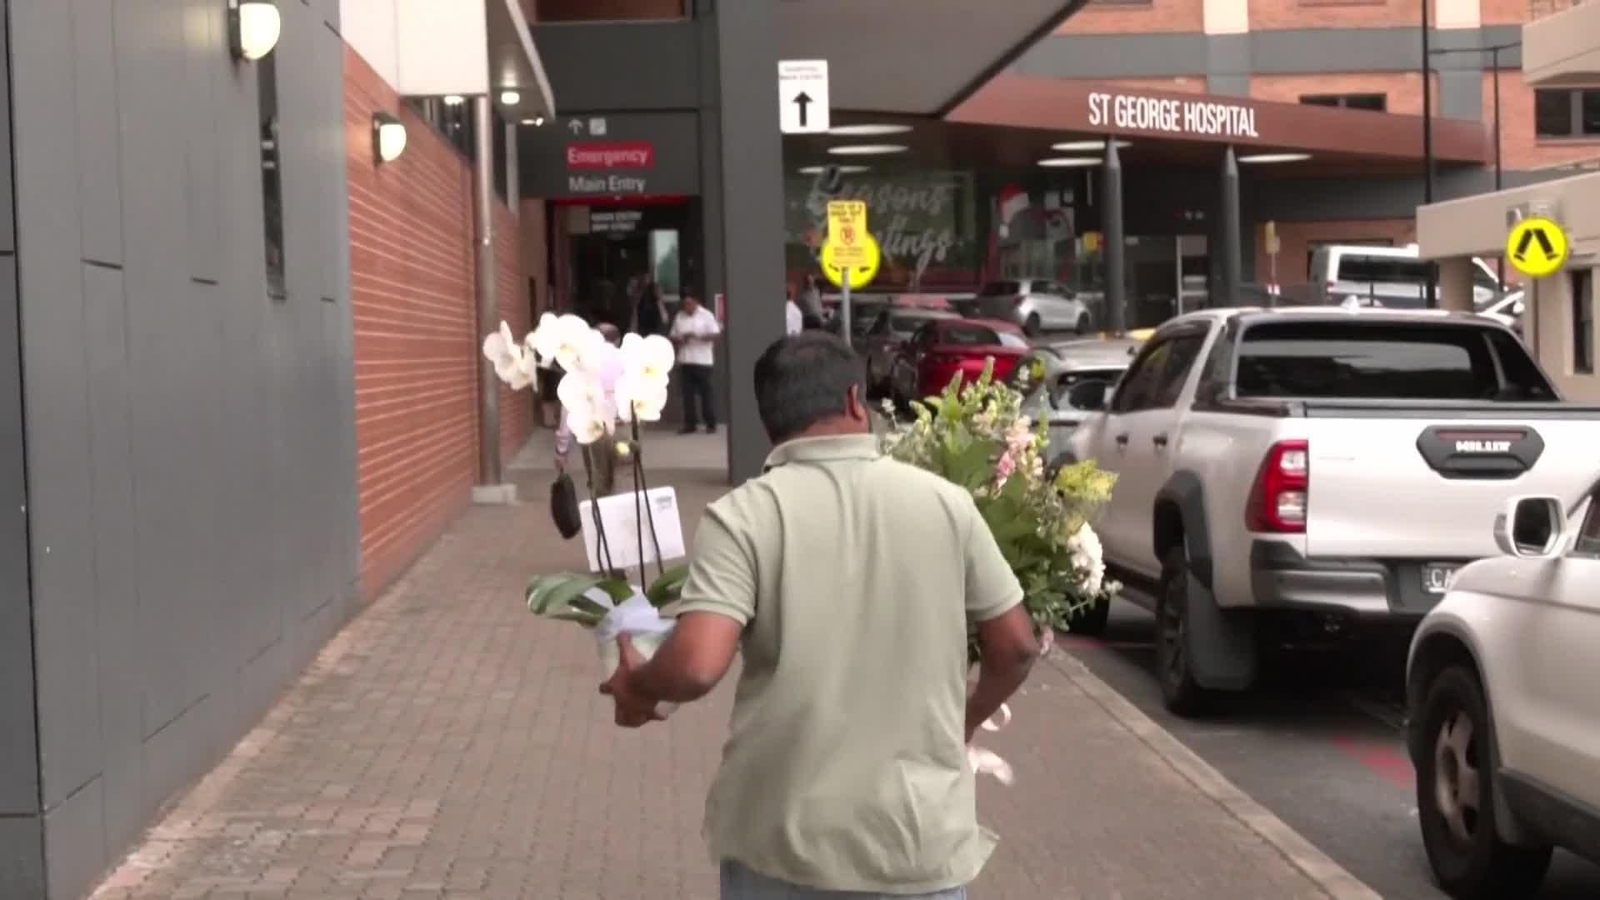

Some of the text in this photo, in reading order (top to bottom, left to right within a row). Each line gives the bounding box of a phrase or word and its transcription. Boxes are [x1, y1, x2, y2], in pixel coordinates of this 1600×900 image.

[1088, 92, 1259, 137] ST GEORGE HOSPITAL
[567, 147, 648, 167] Emergency
[568, 175, 645, 193] Main Entry
